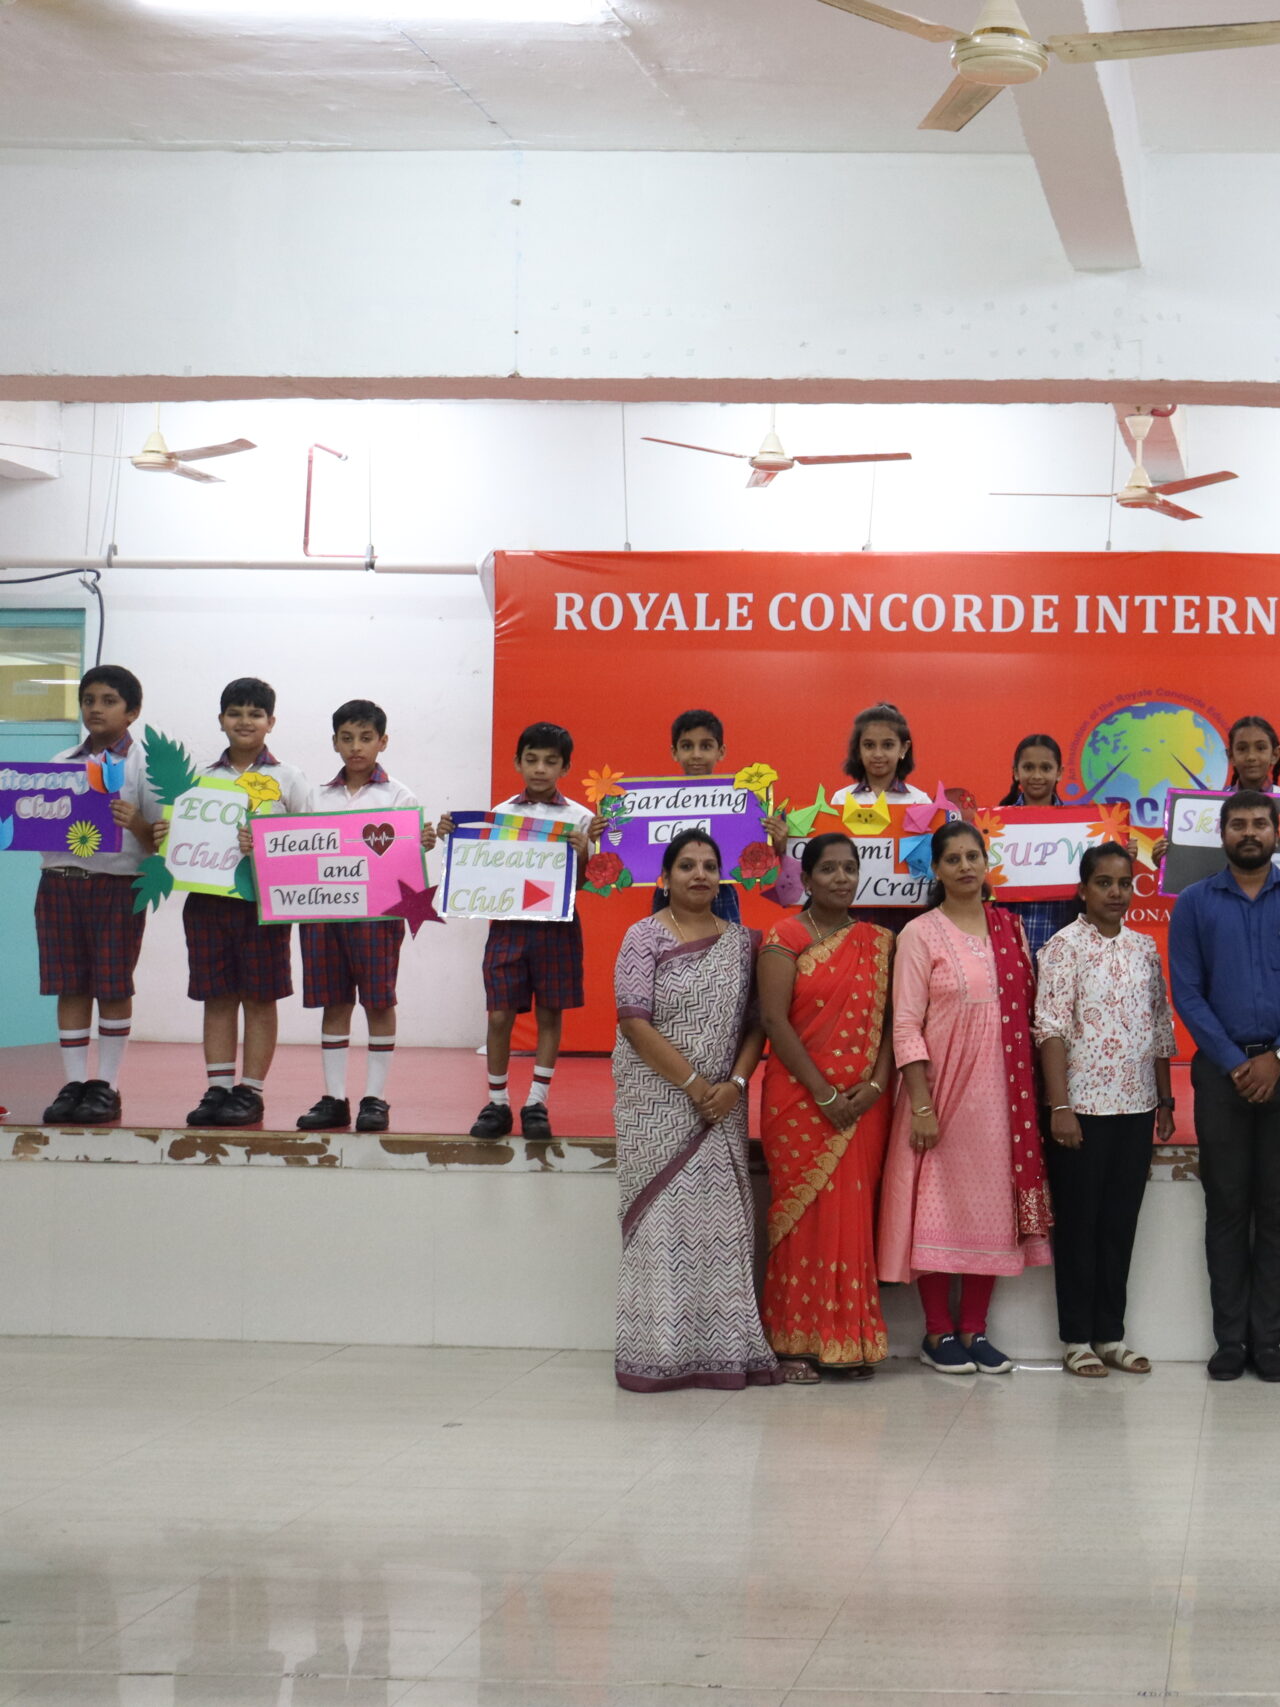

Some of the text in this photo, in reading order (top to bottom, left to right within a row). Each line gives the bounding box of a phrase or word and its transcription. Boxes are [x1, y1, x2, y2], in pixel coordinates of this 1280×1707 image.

[554, 592, 754, 631] ROYALE
[768, 592, 1059, 633] CONCORDE
[0, 768, 89, 794] iterary
[16, 795, 71, 819] Club
[178, 797, 244, 825] ECO
[621, 788, 748, 814] Gardening
[268, 832, 339, 853] Health
[171, 842, 240, 871] Club
[323, 859, 366, 878] and
[453, 842, 566, 870] Theatre
[273, 887, 360, 906] Wellness
[449, 886, 515, 913] Club
